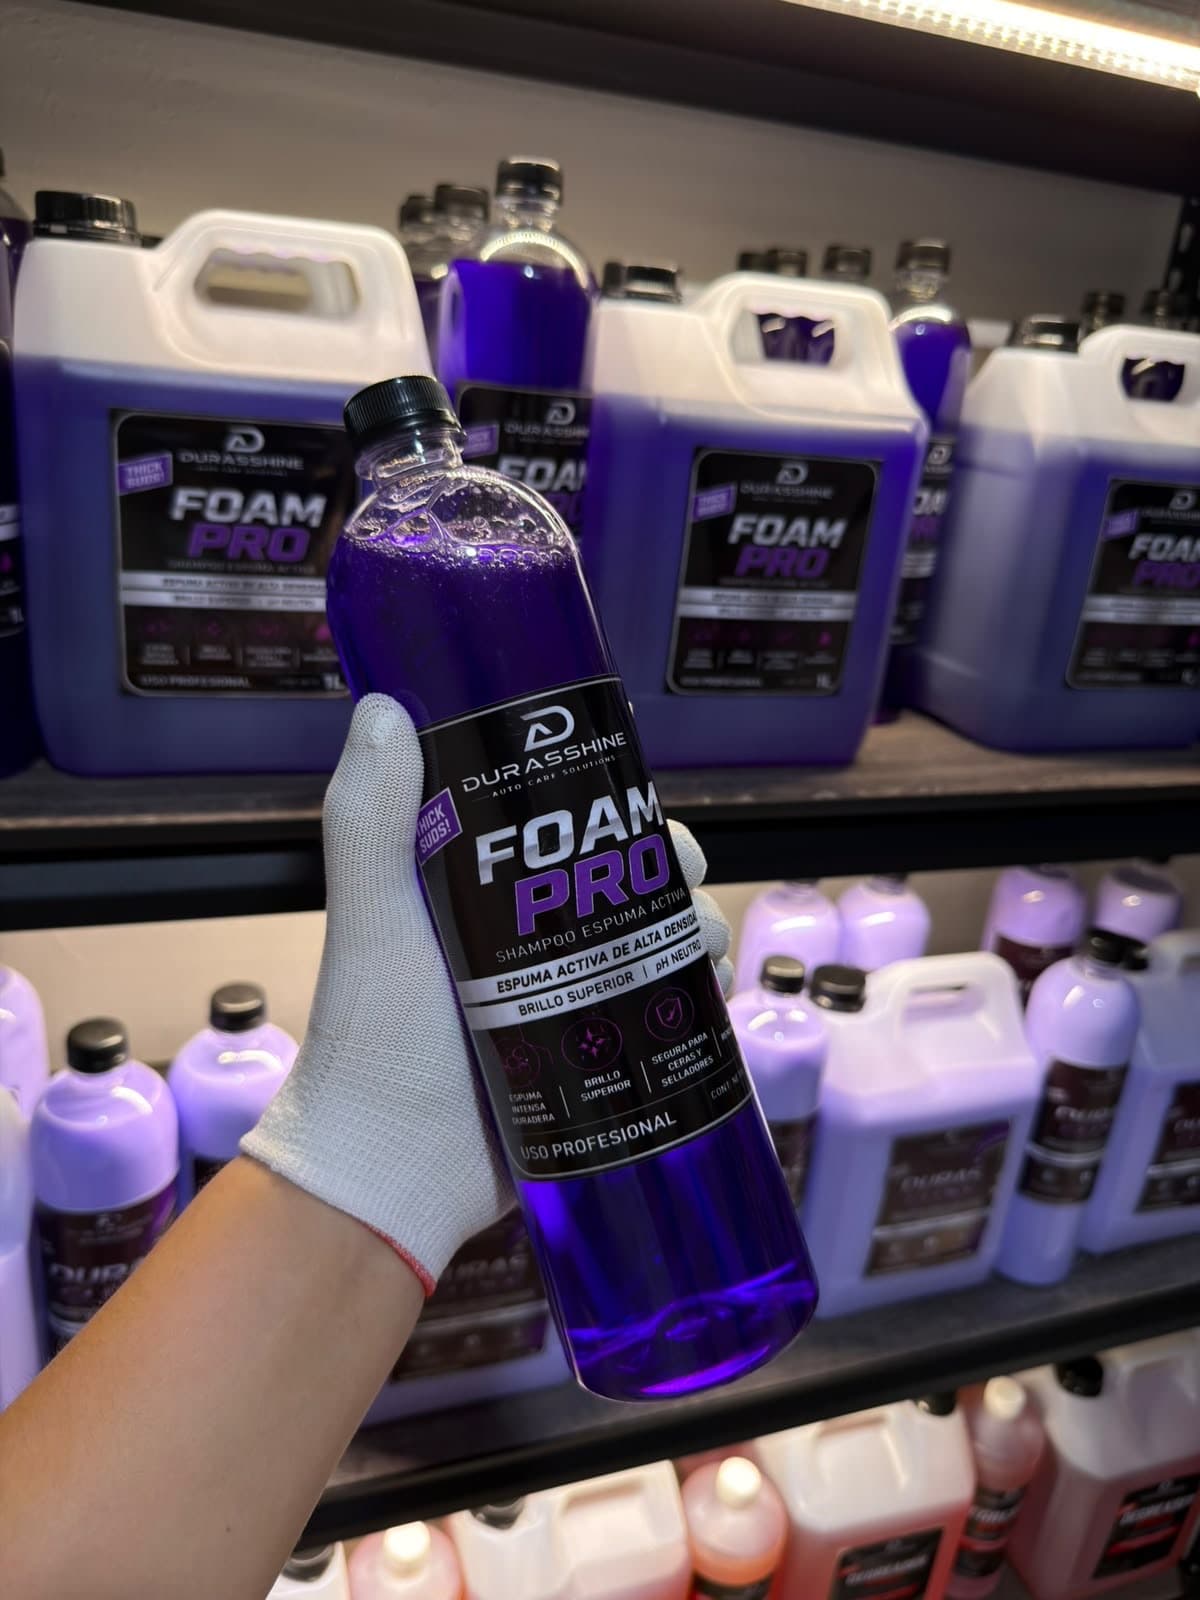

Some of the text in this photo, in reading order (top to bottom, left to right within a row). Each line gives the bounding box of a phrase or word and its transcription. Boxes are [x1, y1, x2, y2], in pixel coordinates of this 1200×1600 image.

[170, 486, 328, 528] FOAM
[187, 522, 310, 563] PRO
[727, 512, 848, 549] FOAM
[734, 544, 830, 579] PRO
[461, 731, 627, 793] DURASSHINE
[492, 755, 616, 798] AUTO CARE SOLUTIONS
[420, 818, 452, 854] SUDS!
[475, 781, 665, 886] FOAM
[514, 833, 671, 937] PRO
[495, 887, 688, 964] SHAMPOO ESPUMA ACTIVA
[496, 911, 698, 994] ESPUMA ACTIVA DE ALTA DENSIDA
[518, 939, 702, 1017] BRILLO SUPERIOR pH NEUTRO
[651, 1043, 688, 1065] SEGURA
[688, 1032, 708, 1049] PARA
[667, 1051, 697, 1072] CERAS
[584, 1070, 621, 1089] BRILLO
[661, 1055, 714, 1088] SELLADORES
[508, 1091, 543, 1102] ESPUMA
[511, 1102, 547, 1113] INTENSA
[580, 1079, 632, 1102] SUPERIOR
[511, 1113, 556, 1125] DURADERA
[520, 1110, 677, 1160] USO PROFESIONAL
